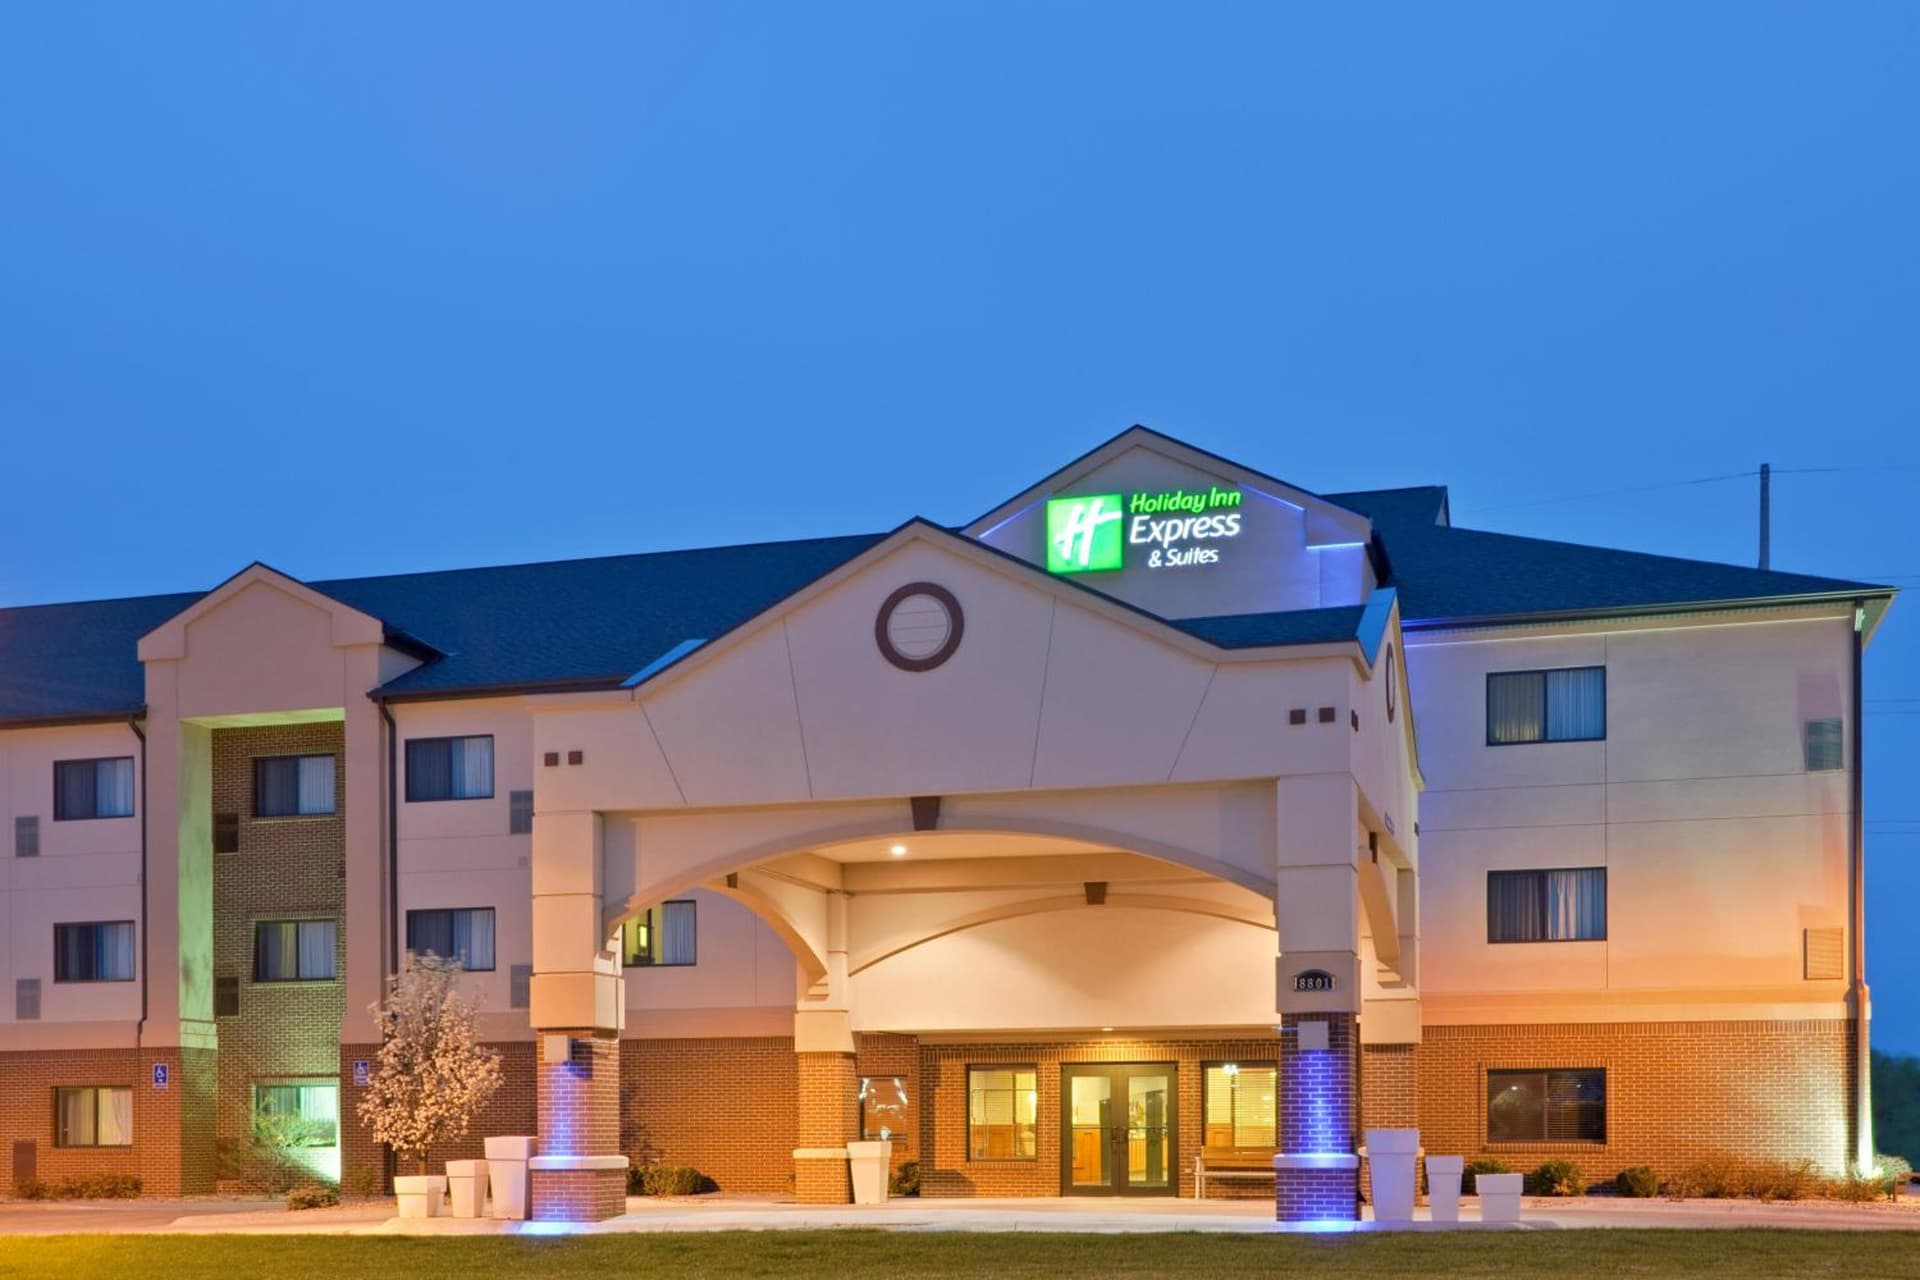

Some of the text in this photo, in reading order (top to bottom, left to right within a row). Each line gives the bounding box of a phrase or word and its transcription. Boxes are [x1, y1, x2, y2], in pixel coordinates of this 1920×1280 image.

[1130, 487, 1241, 513] Holiday Inn
[1129, 513, 1241, 548] Express
[1148, 548, 1219, 568] & Suites
[1299, 977, 1329, 990] 8801
